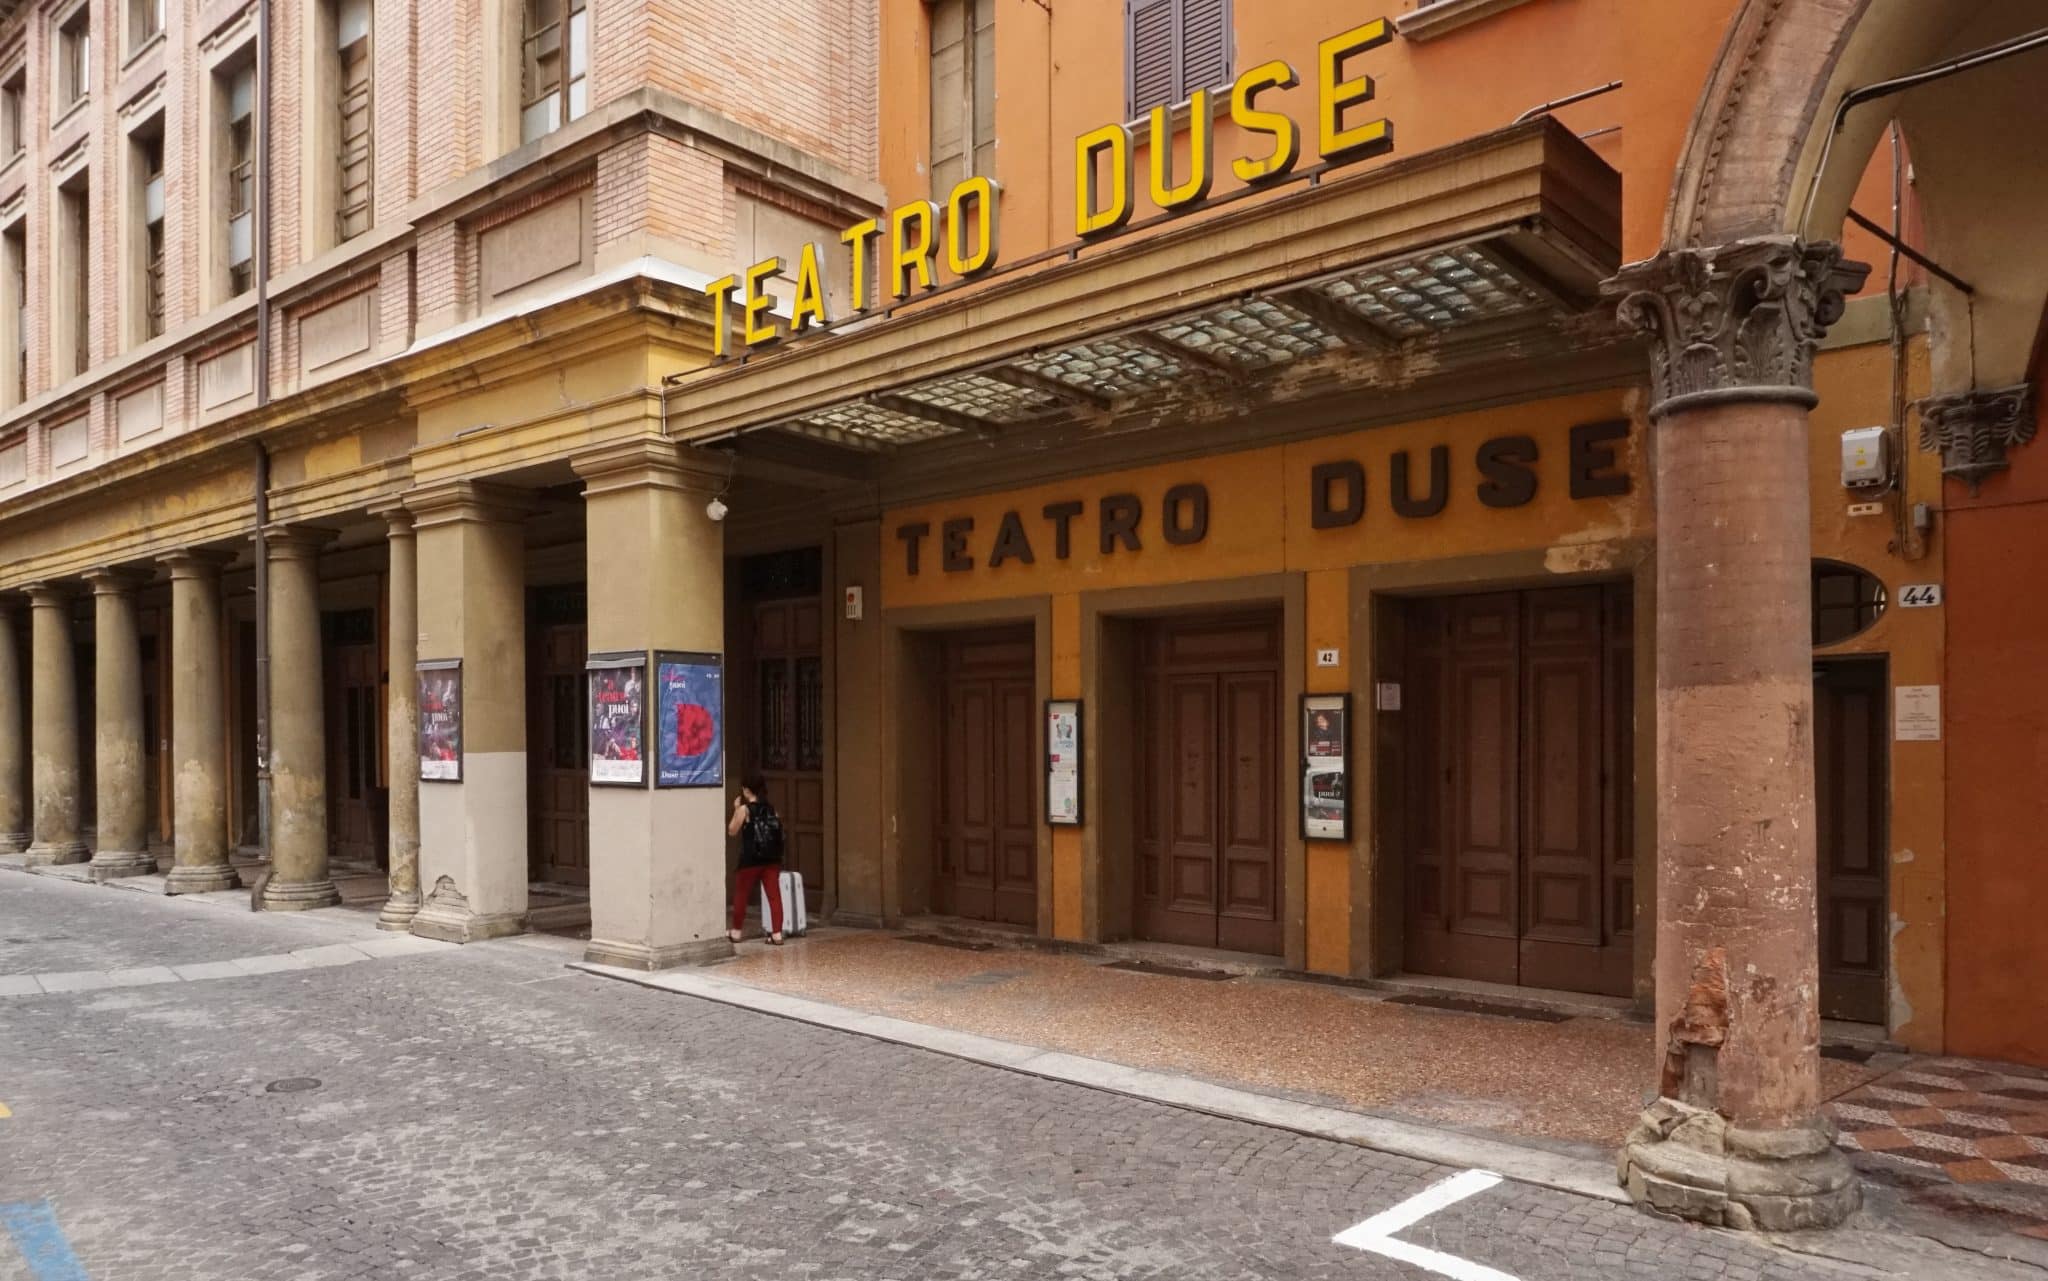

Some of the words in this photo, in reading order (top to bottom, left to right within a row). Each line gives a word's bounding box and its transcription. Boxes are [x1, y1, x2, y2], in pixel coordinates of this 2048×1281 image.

[706, 176, 1000, 357] TEATRO
[1076, 17, 1393, 236] DUSE
[897, 484, 1209, 576] TEATRO
[1311, 418, 1632, 530] DUSE
[1903, 587, 1935, 605] 44
[1322, 652, 1333, 662] 42
[608, 700, 629, 718] puoi
